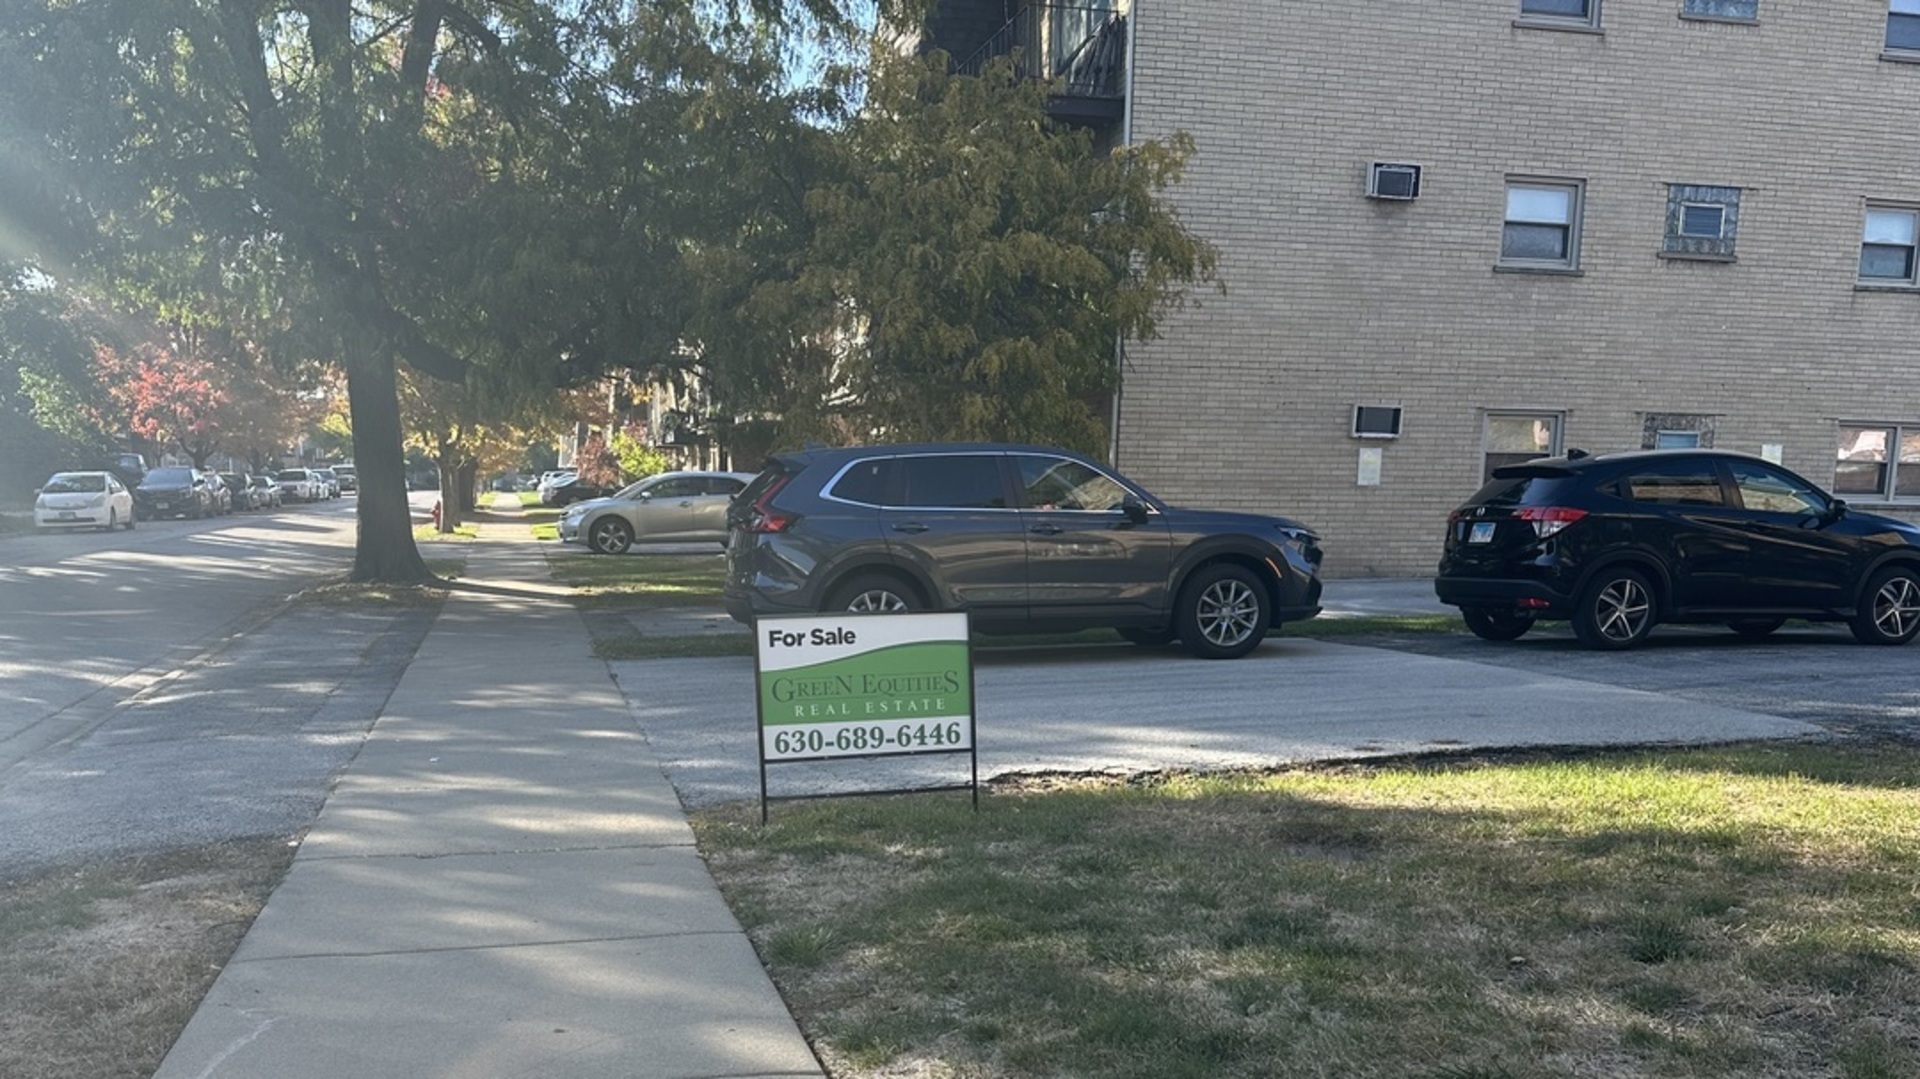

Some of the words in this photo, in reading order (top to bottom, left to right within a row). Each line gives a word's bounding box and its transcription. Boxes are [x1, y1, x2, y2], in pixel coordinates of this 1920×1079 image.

[769, 630, 805, 647] For
[810, 627, 856, 645] Sale
[772, 675, 853, 702] GREEN
[862, 669, 960, 697] EQUITIES
[795, 703, 851, 717] REAL
[866, 699, 946, 714] ESTATE
[775, 722, 961, 753] 630-689-6446
